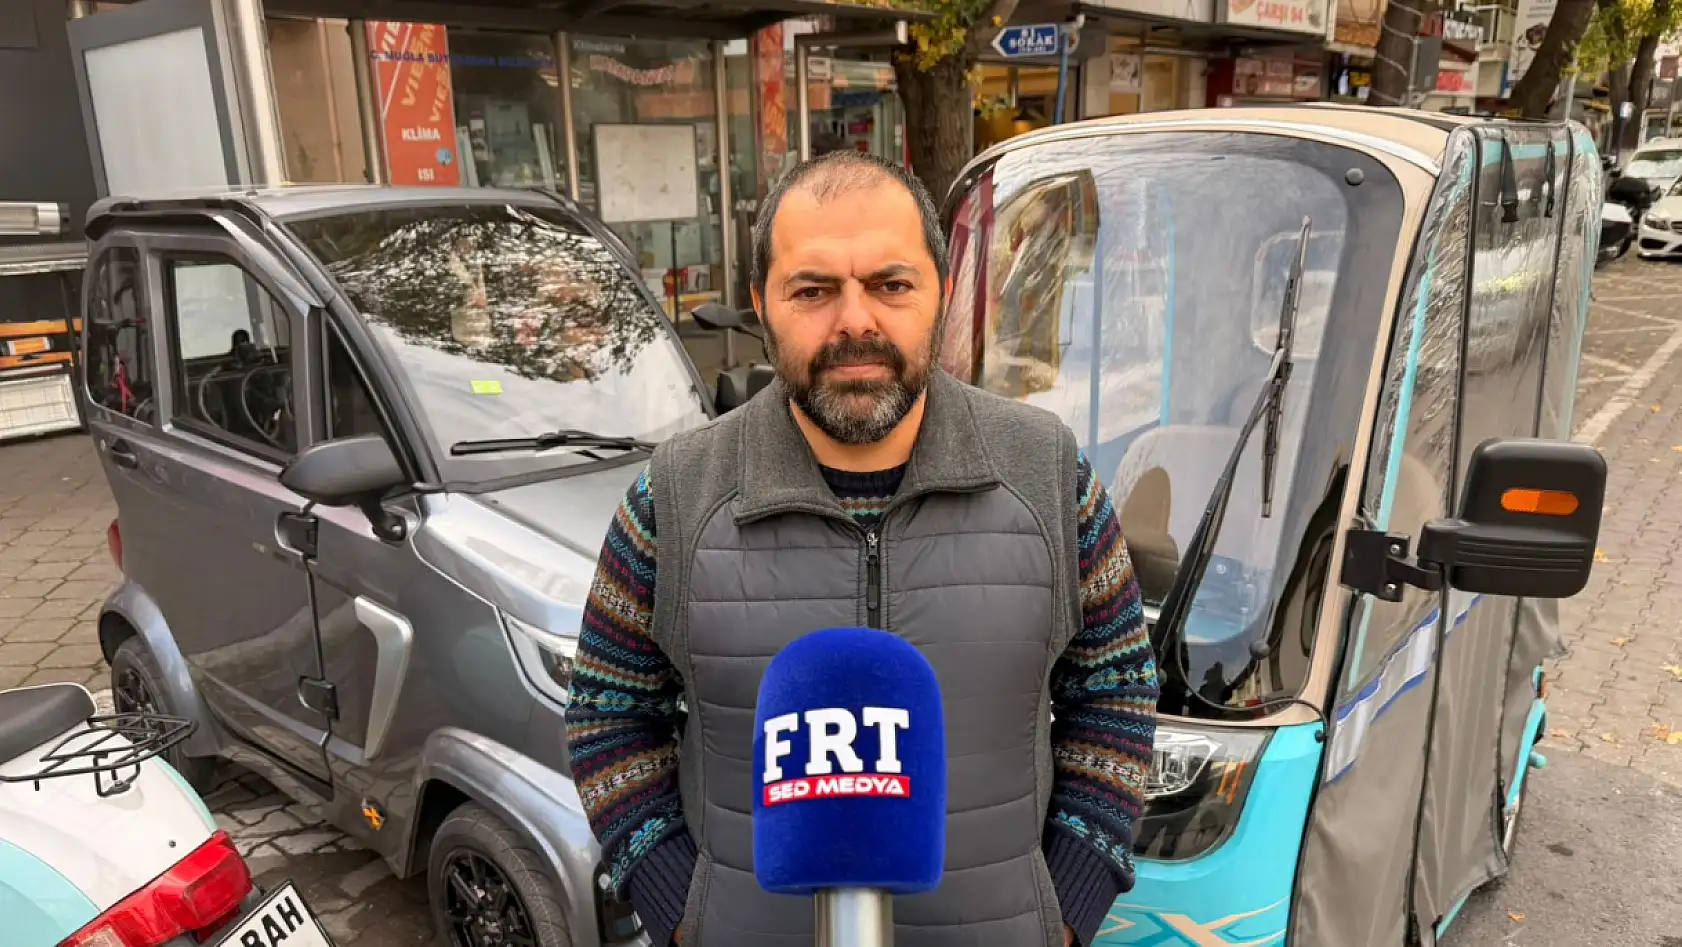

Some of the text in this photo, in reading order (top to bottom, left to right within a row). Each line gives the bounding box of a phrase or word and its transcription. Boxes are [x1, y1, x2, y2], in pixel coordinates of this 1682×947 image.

[1009, 33, 1053, 49] SOKAK
[401, 126, 441, 141] KLİMA
[763, 706, 910, 783] FRT
[768, 775, 904, 802] SED MEDYA
